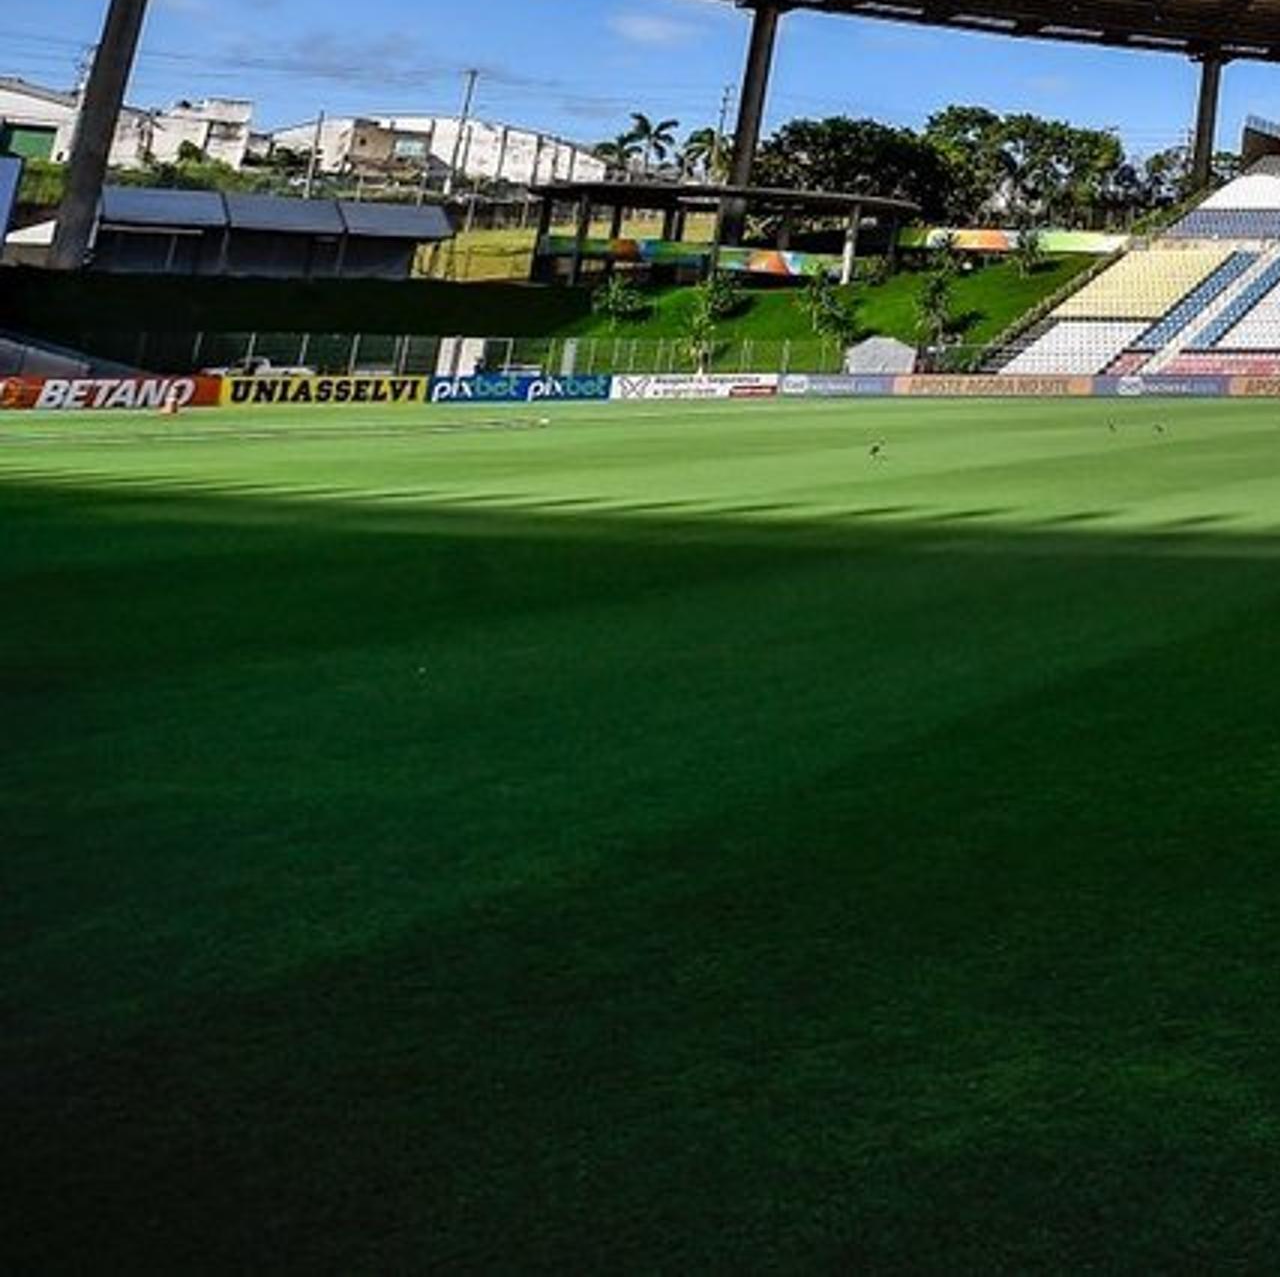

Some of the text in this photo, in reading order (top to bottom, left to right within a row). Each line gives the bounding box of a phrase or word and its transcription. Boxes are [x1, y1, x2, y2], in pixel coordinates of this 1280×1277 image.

[36, 378, 195, 408] BETANO
[231, 379, 419, 403] UNIASSELVI
[432, 375, 518, 403] pixbet
[527, 376, 606, 402] pixbet
